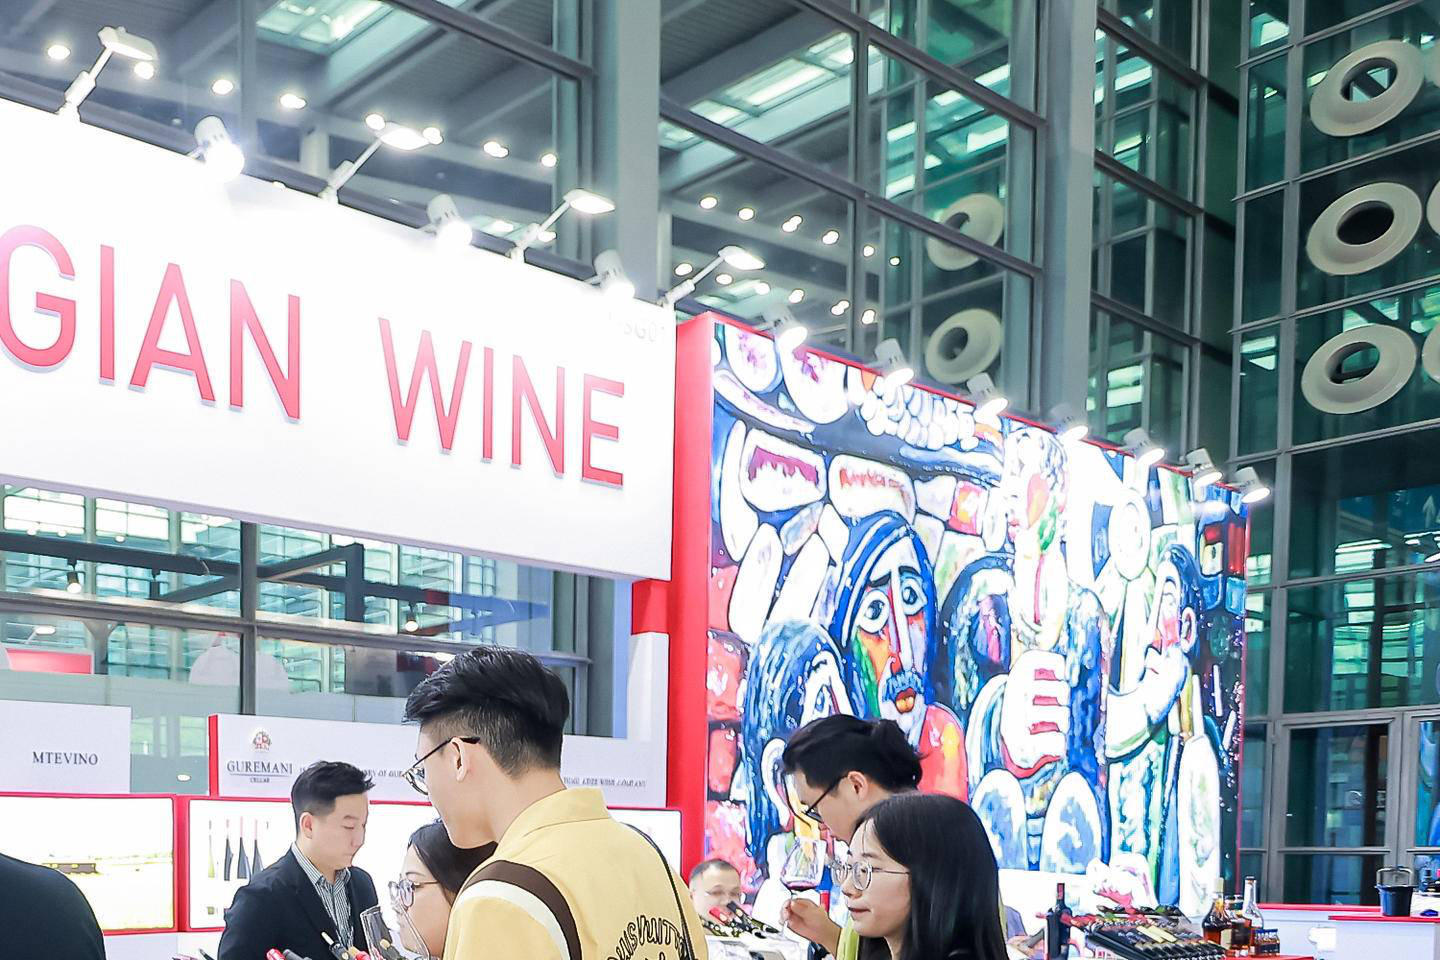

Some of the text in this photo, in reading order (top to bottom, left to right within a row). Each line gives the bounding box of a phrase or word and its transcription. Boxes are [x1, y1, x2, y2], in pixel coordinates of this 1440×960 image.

[378, 317, 625, 488] WINE
[32, 751, 98, 766] MTEVINO
[226, 761, 293, 775] GUREMANI
